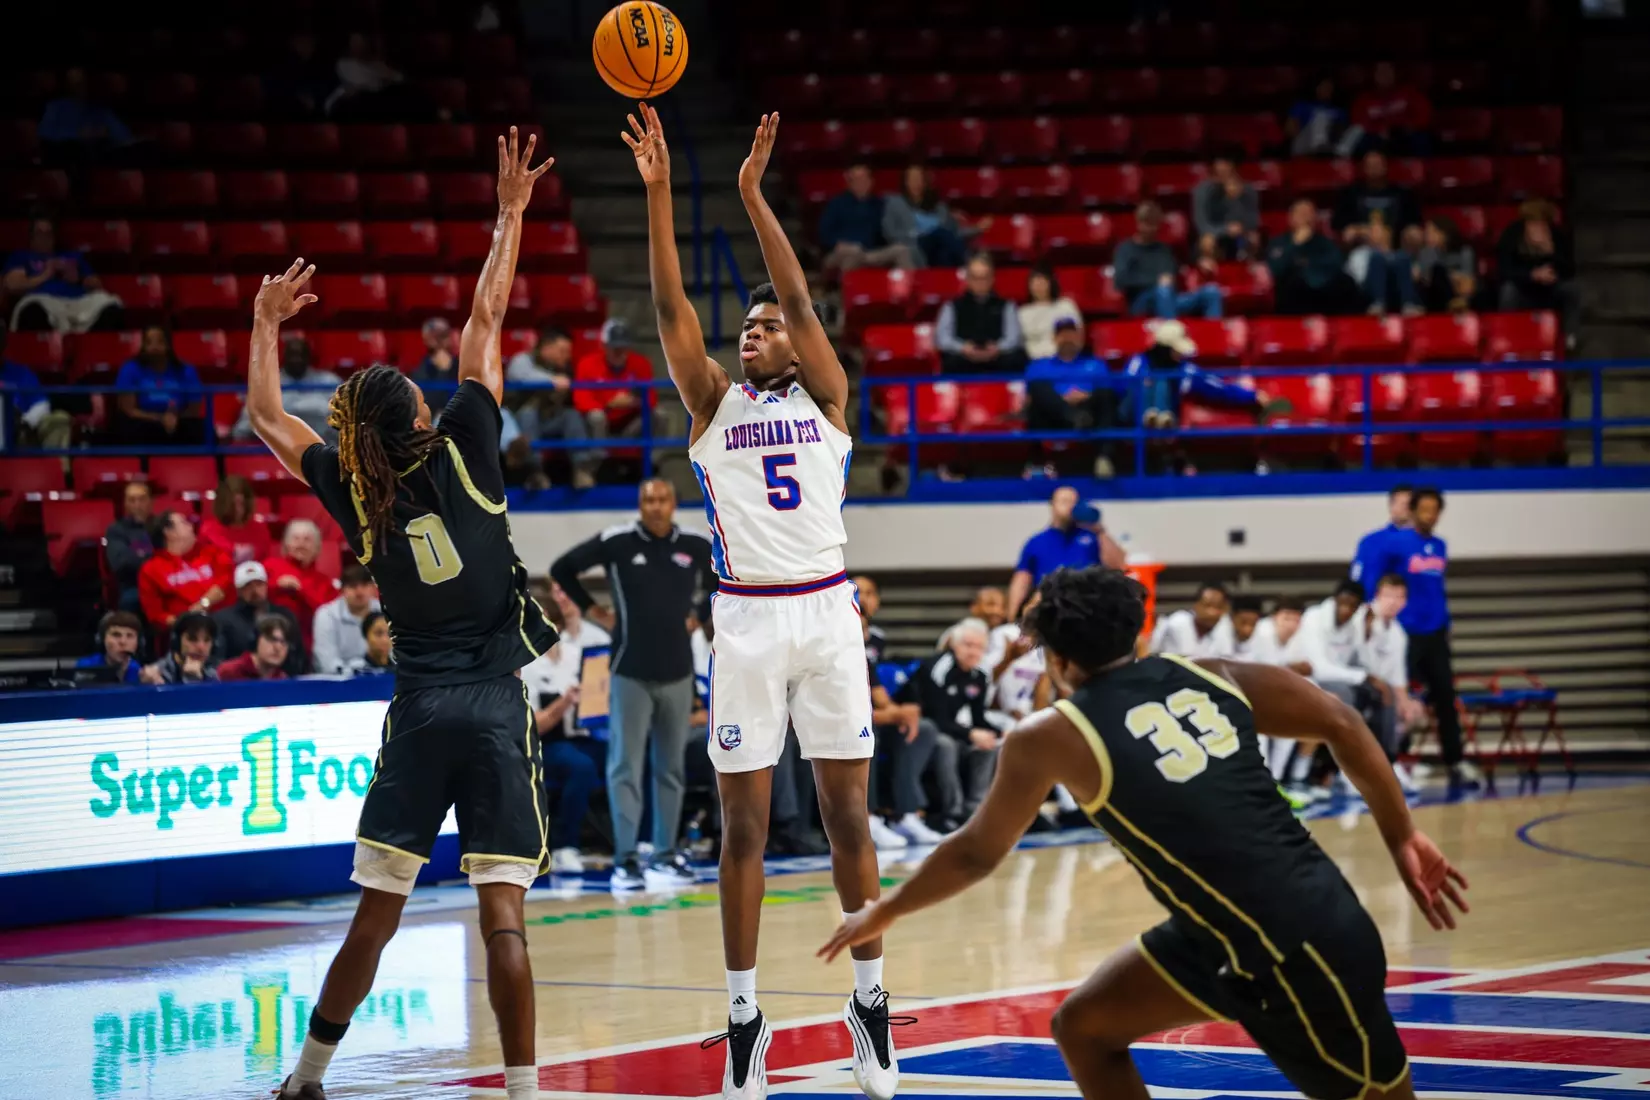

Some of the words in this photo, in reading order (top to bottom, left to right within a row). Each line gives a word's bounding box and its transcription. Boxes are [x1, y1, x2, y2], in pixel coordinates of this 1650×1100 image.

[628, 8, 650, 48] NCAA
[724, 420, 794, 451] LOUISIANA
[761, 453, 802, 511] 5
[405, 512, 464, 586] 0
[1124, 687, 1240, 784] 33
[90, 752, 239, 830] Super
[241, 725, 287, 836] 1
[287, 739, 373, 801] Foo
